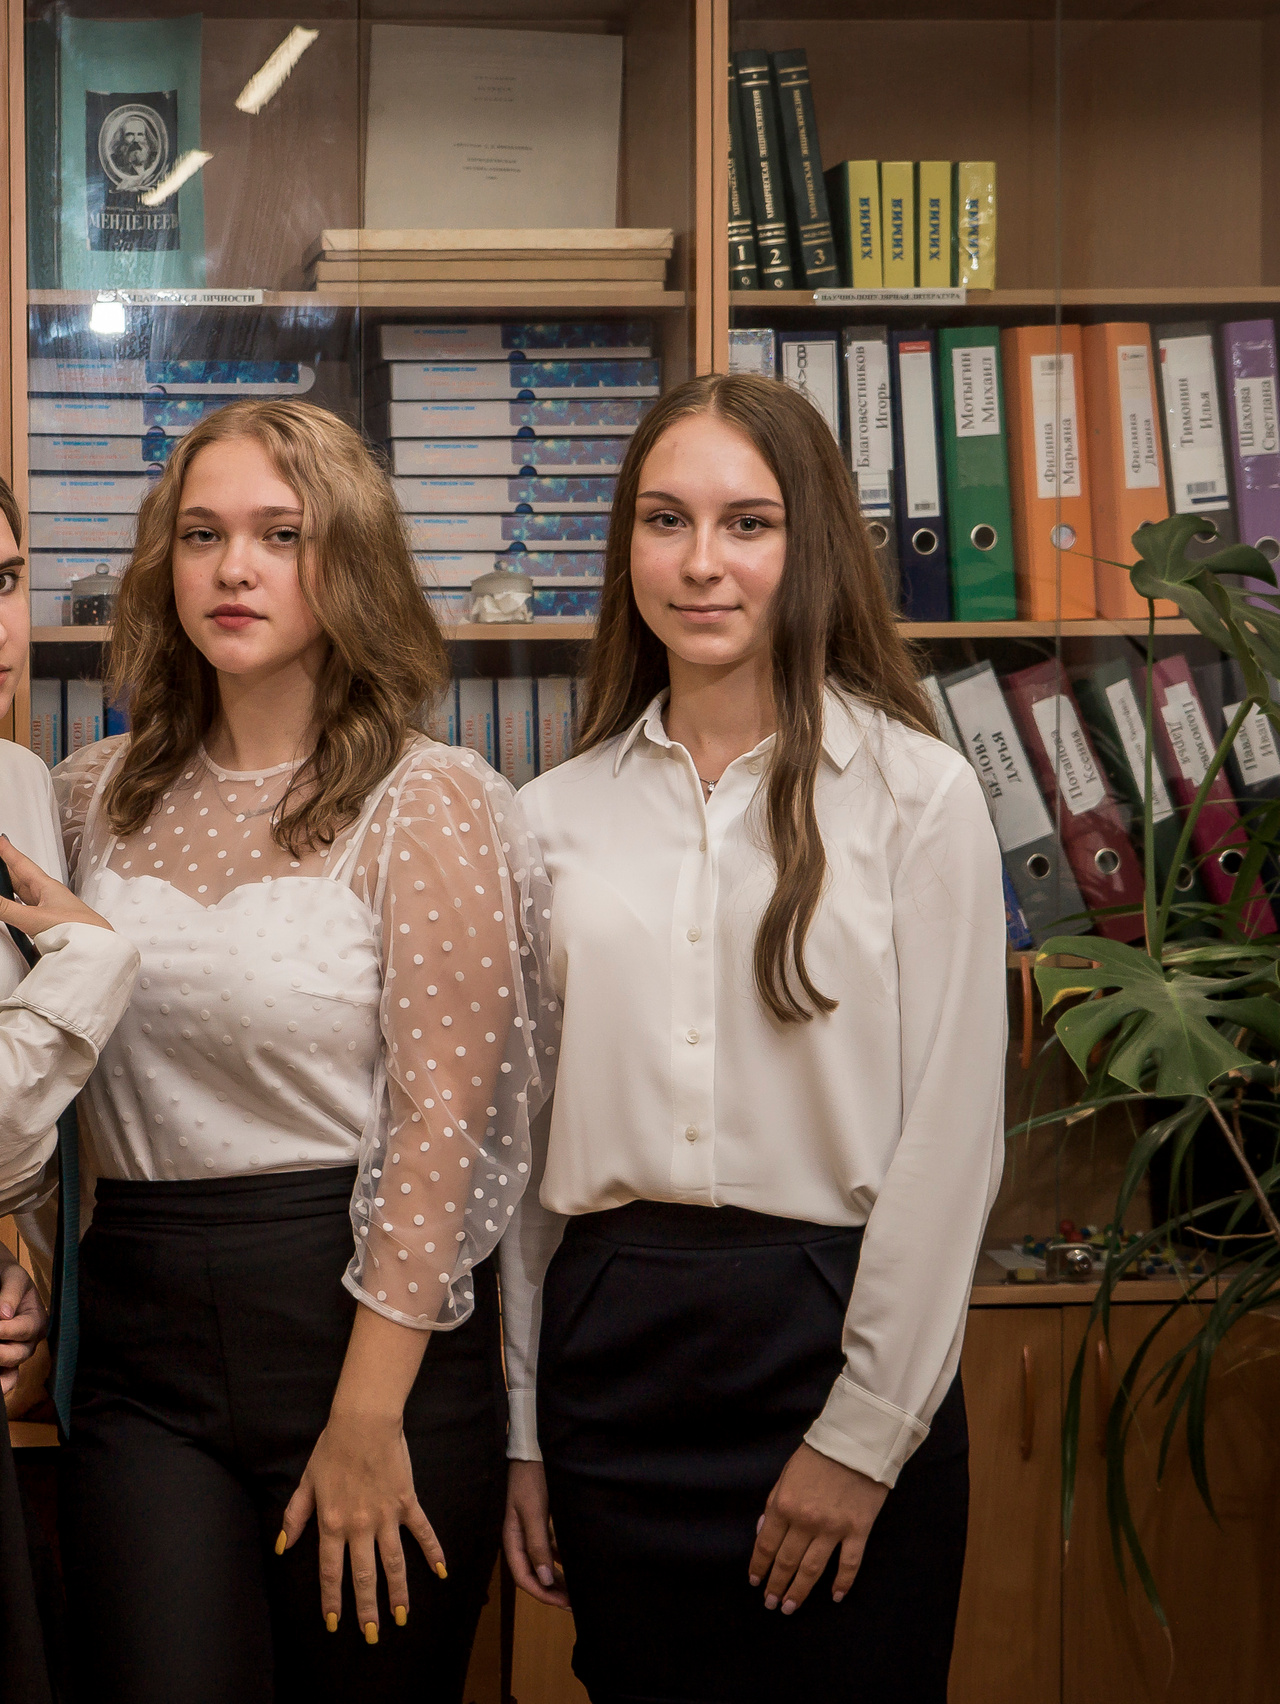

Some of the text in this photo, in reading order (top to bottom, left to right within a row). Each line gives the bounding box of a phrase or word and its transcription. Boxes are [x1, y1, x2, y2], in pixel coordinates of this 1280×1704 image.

[737, 244, 746, 261] 1
[769, 248, 782, 265] 2
[814, 248, 826, 265] 3
[859, 197, 873, 260] ХИМИЯ
[891, 198, 904, 261] ХИМИЯ
[928, 198, 941, 261] ХИМИЯ
[201, 294, 255, 303] ЛИЧНОСТИ
[855, 345, 869, 468] Благовестников
[875, 382, 888, 429] Игорь
[960, 352, 975, 430] Мотыгин
[981, 356, 996, 423] Михаил
[1179, 377, 1194, 448] Тимонин
[1199, 391, 1213, 430] Илья
[1240, 386, 1255, 447] Шахова
[1261, 379, 1276, 451] Светлана
[1043, 422, 1055, 483] Филина
[1062, 417, 1077, 485] Марьяна
[1129, 413, 1141, 474] Филина
[1144, 418, 1157, 466] Диана
[972, 732, 1003, 799] БЕЛОВА
[991, 731, 1021, 784] ДАРЬЯ
[1051, 728, 1083, 800] Потапова
[1070, 730, 1097, 784] Ксения
[1166, 721, 1190, 765] Дарья
[1238, 725, 1258, 771] Павло
